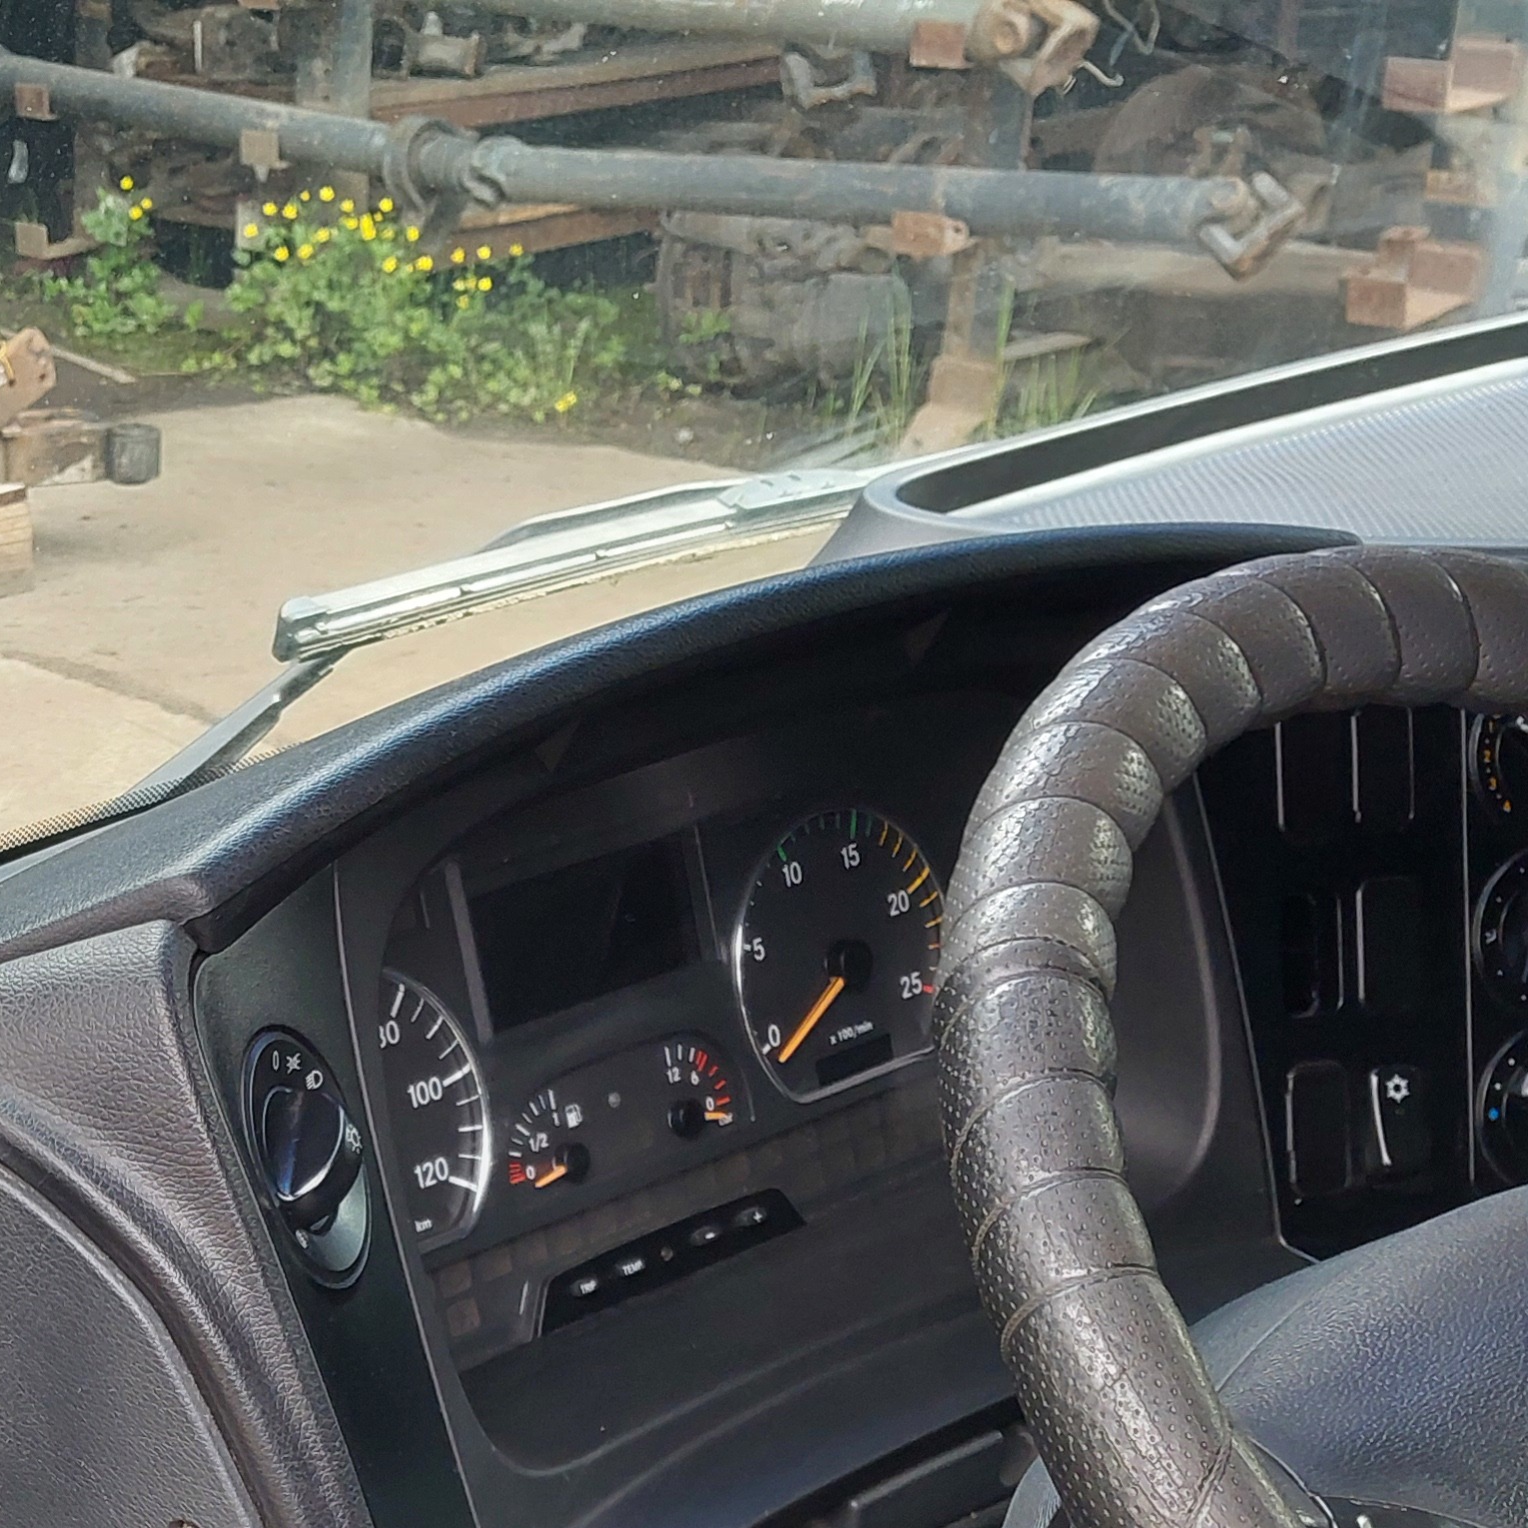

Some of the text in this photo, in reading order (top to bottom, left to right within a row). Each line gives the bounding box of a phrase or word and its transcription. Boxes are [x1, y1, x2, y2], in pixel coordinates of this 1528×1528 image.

[840, 844, 861, 870] 15
[781, 861, 803, 888] 10
[887, 890, 910, 917] 20
[752, 937, 766, 961] 5
[899, 971, 923, 999] 25
[767, 1024, 781, 1048] 0
[666, 1066, 682, 1084] 12
[690, 1070, 700, 1086] 6
[406, 1076, 444, 1109] 100
[705, 1095, 715, 1111] 0
[413, 1156, 450, 1189] 120
[525, 1164, 536, 1181] 0
